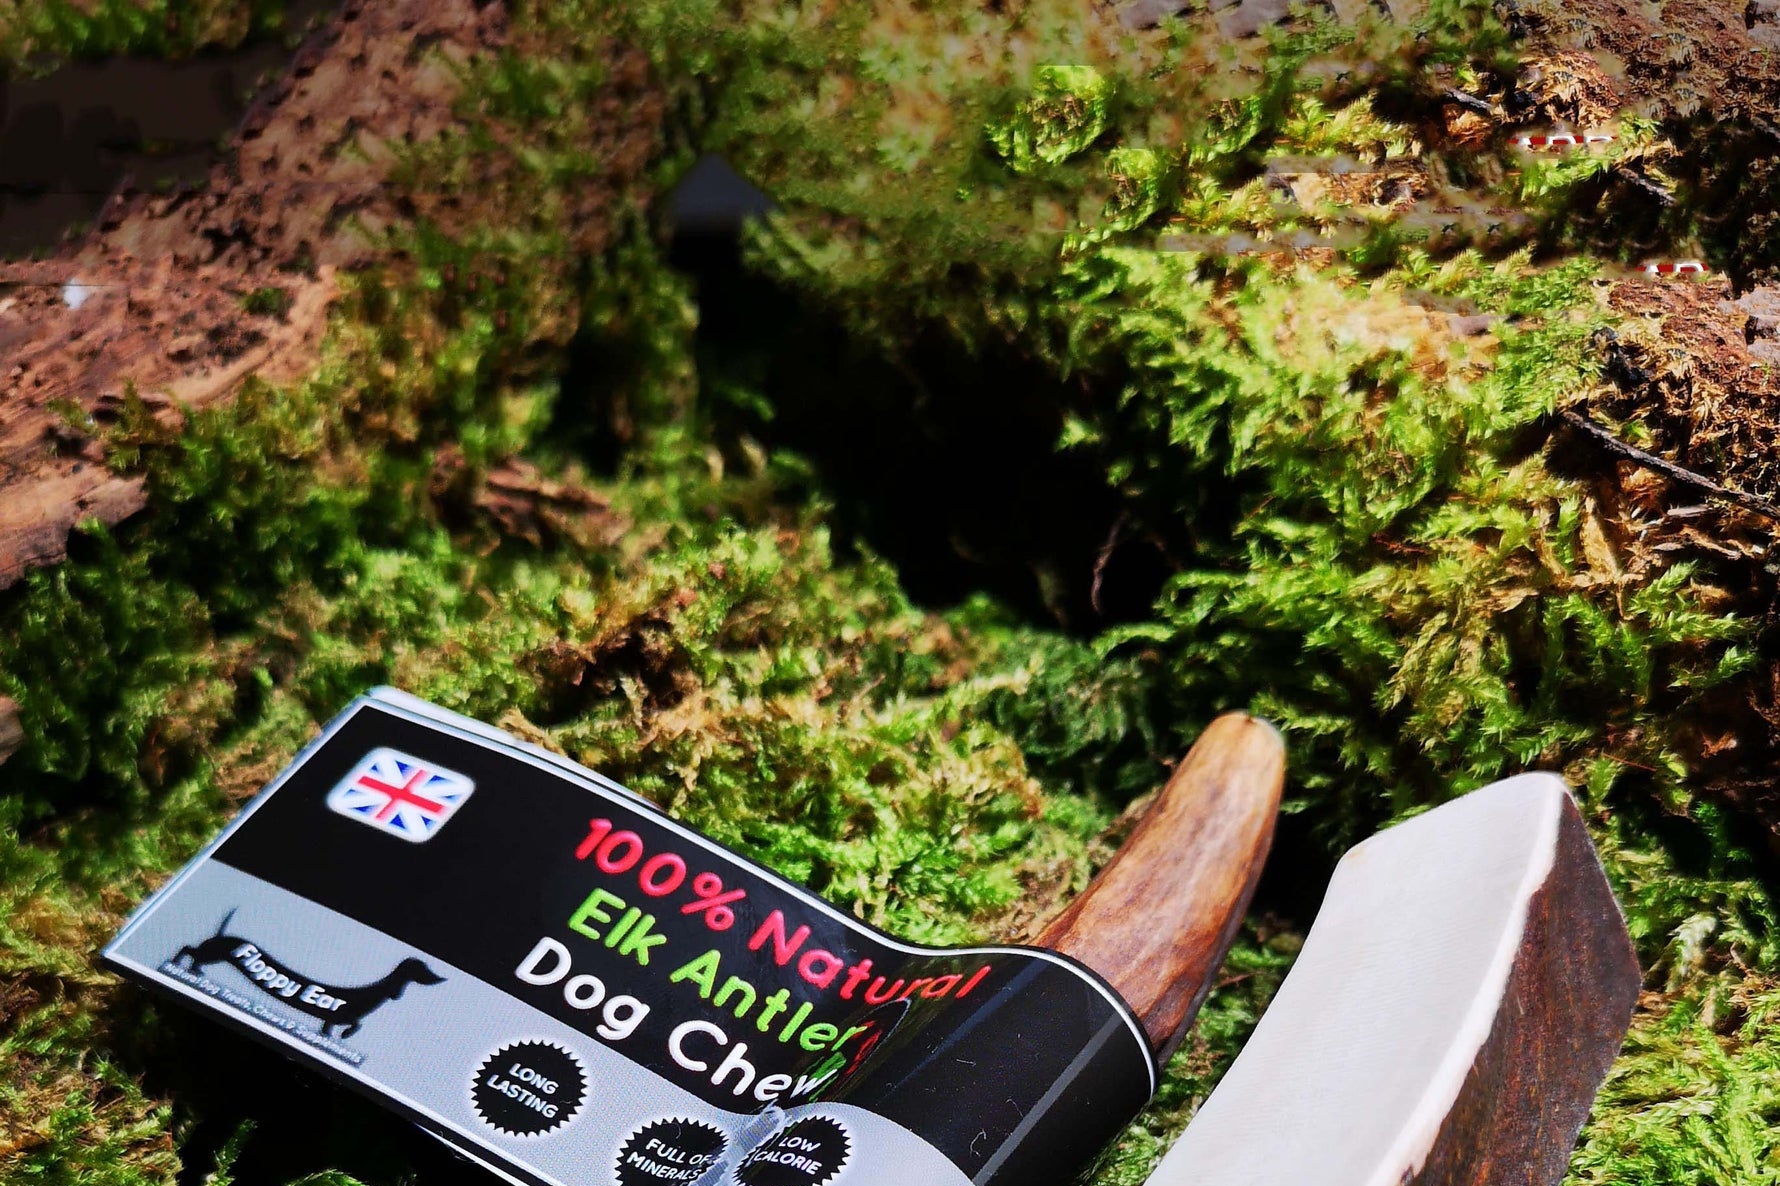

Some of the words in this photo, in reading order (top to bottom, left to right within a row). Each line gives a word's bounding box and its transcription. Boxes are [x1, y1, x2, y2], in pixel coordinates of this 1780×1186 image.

[575, 818, 746, 931] 100%
[748, 909, 992, 1005] Natural
[231, 943, 301, 997] Floppy
[300, 984, 347, 1012] Ear
[568, 887, 667, 966] Elk
[670, 949, 867, 1051] Antler
[514, 936, 651, 1040] Dog
[668, 1020, 837, 1101] Chew
[486, 1074, 559, 1119] LASTING
[507, 1062, 559, 1095] LONG
[645, 1138, 684, 1164] FULL
[689, 1153, 712, 1165] OF
[753, 1150, 822, 1175] CALORIE
[778, 1136, 821, 1152] LOW
[626, 1151, 702, 1181] MINERALS
